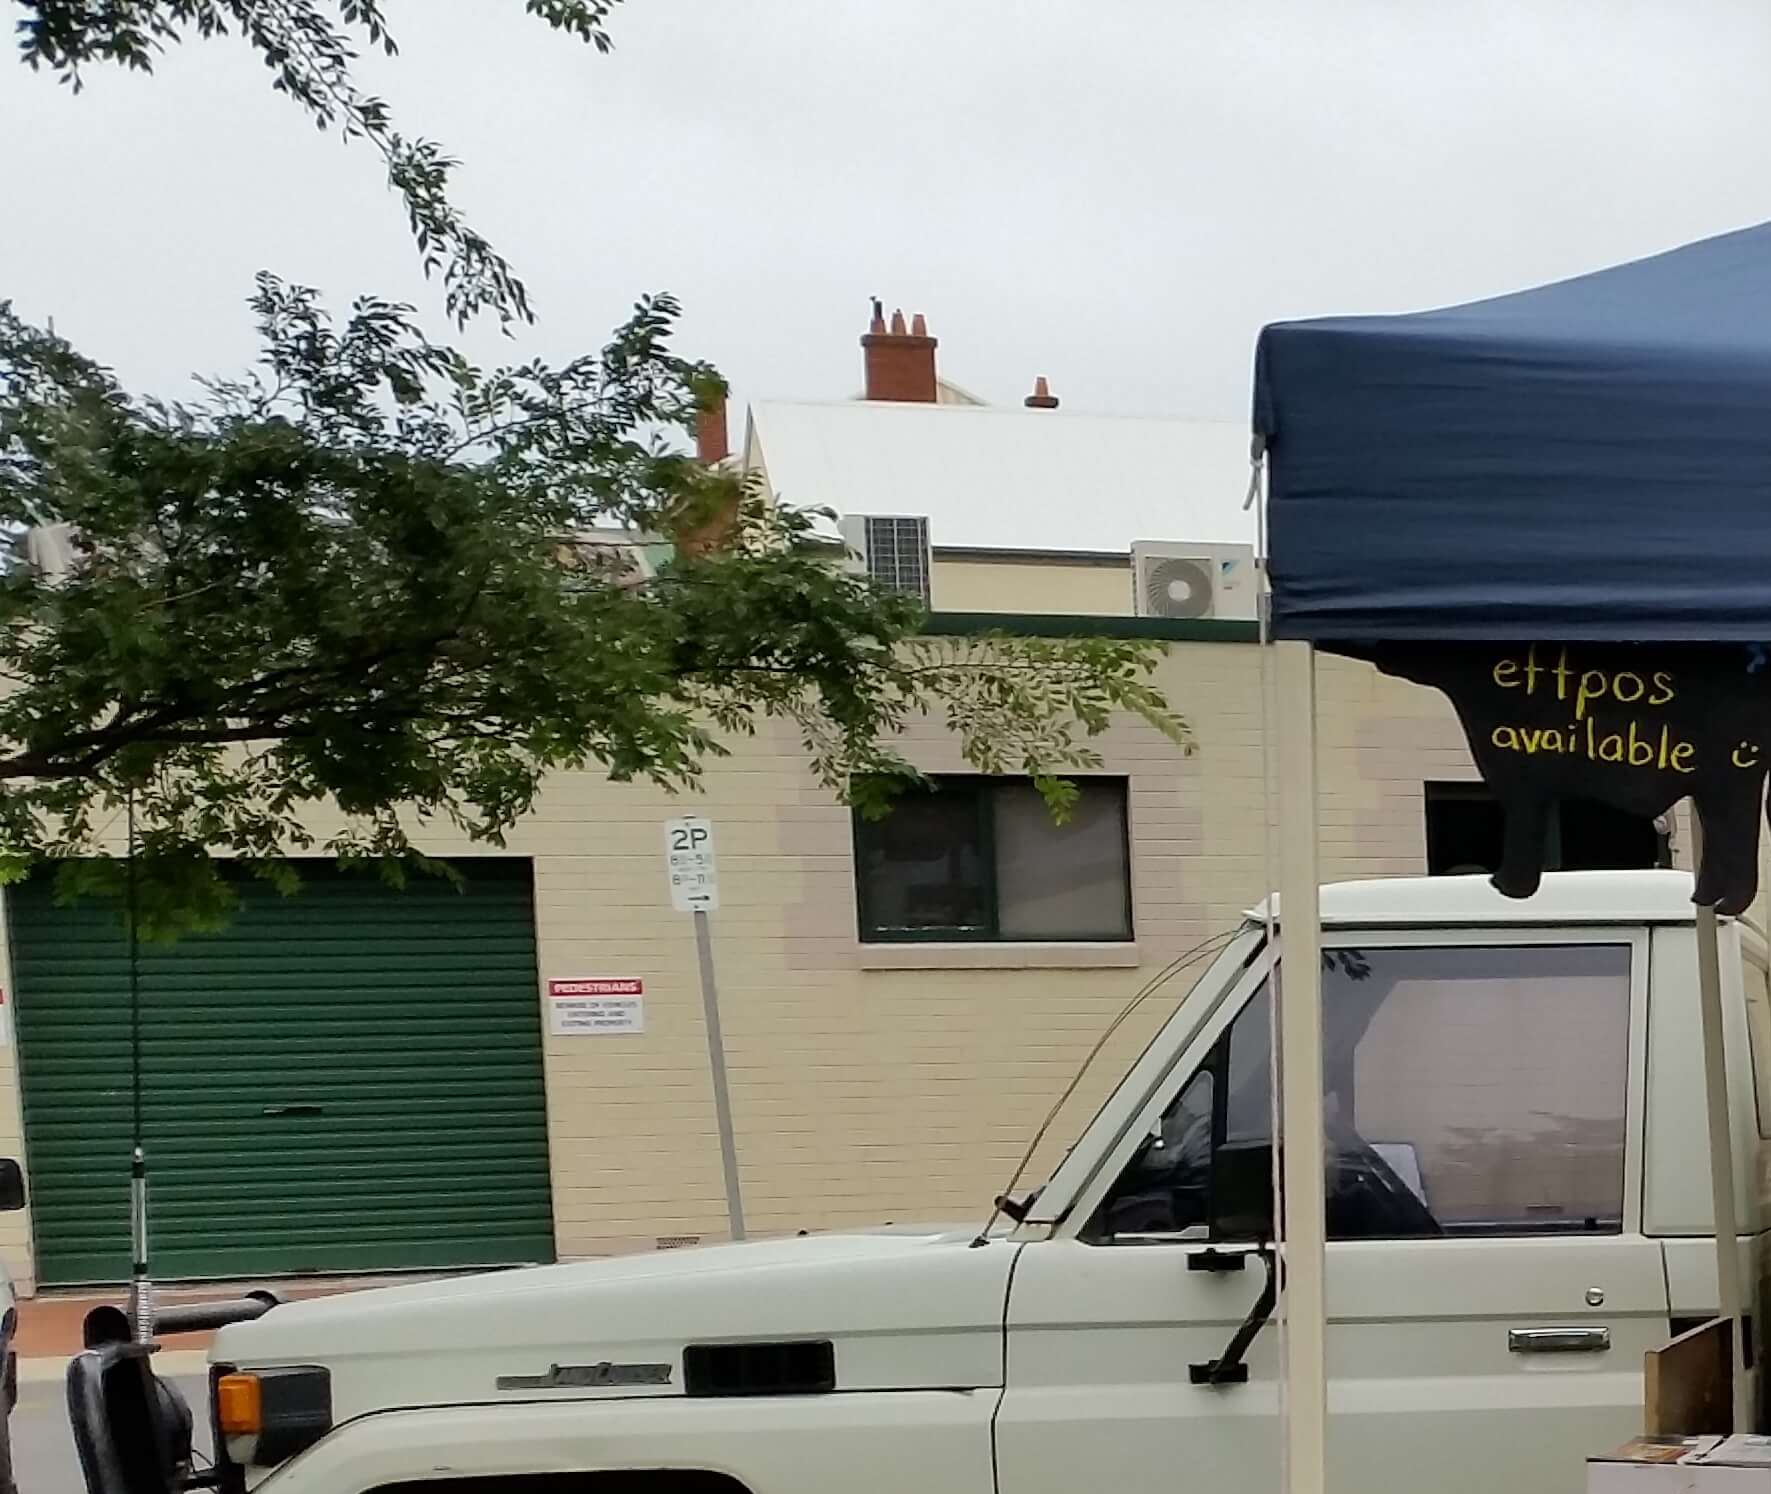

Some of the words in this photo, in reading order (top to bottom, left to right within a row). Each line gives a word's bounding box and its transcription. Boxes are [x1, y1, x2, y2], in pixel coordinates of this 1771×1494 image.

[1491, 717, 1696, 773] available
[671, 828, 708, 850] 2P
[554, 982, 638, 993] PEDESTRIANS
